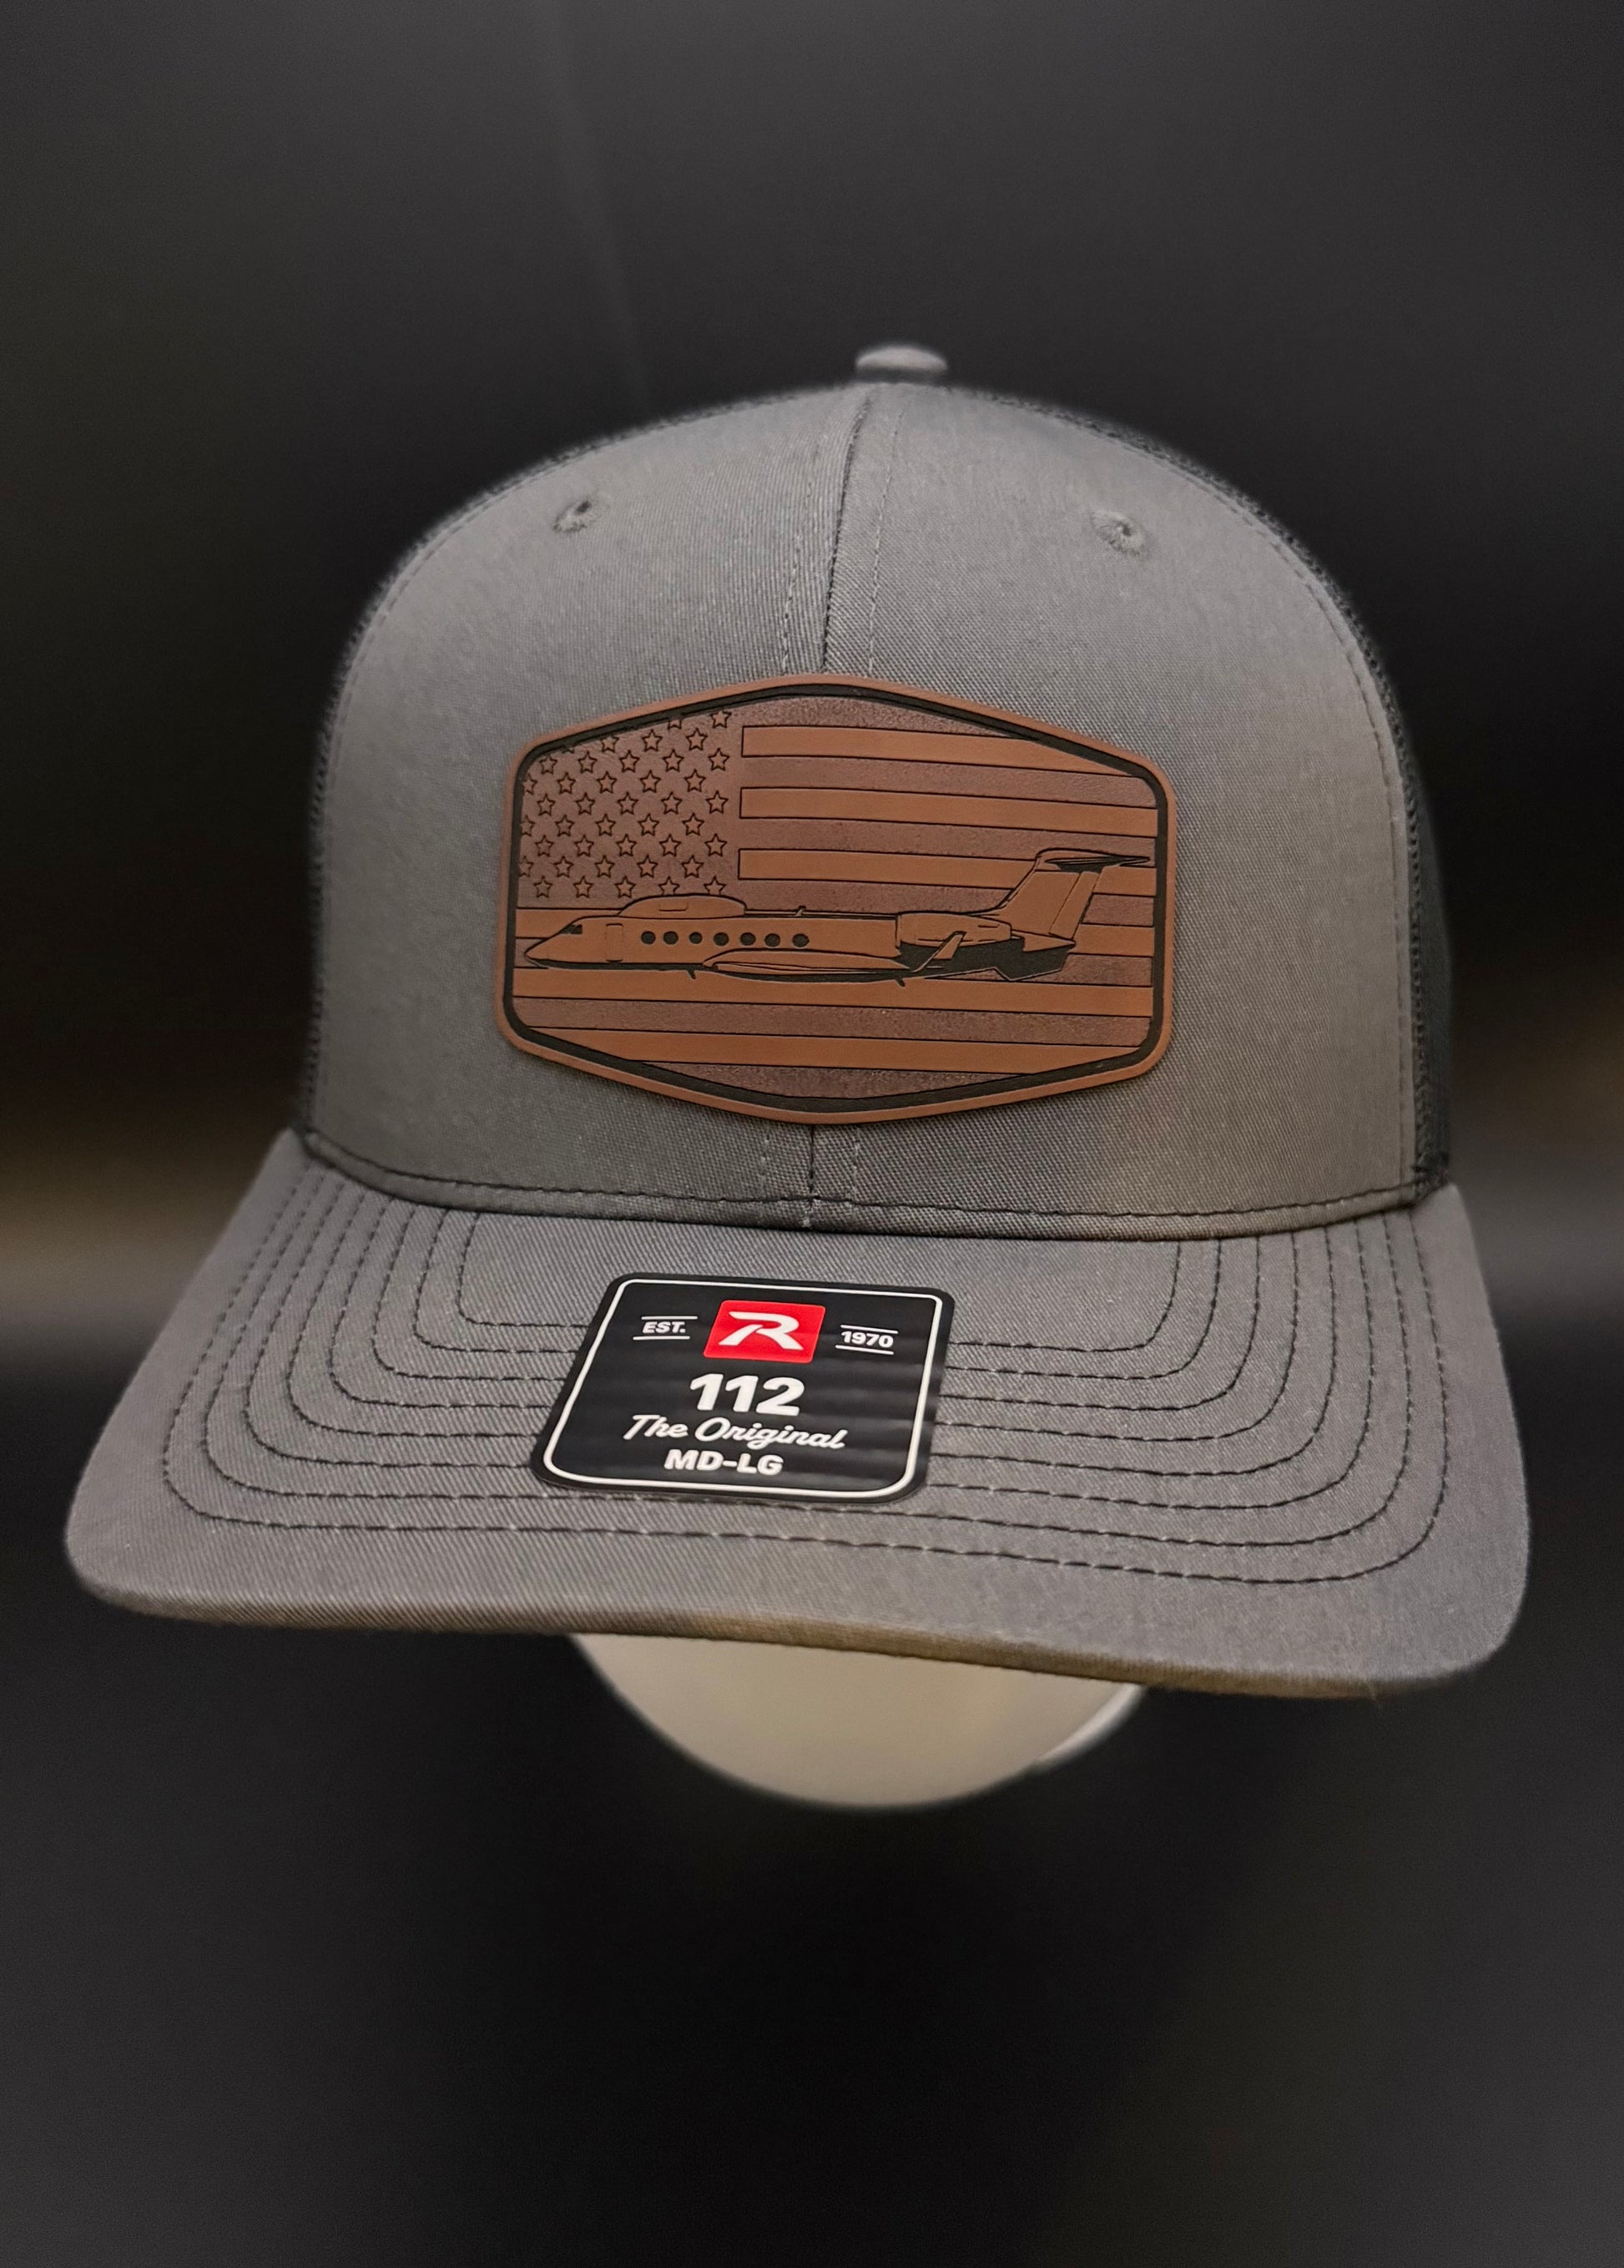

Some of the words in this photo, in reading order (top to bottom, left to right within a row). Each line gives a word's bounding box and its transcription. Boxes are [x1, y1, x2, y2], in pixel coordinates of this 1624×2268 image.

[642, 1321, 686, 1334] EST.
[718, 1311, 804, 1351] R
[840, 1331, 894, 1348] 1970
[689, 1373, 805, 1417] 112
[623, 1414, 688, 1441] The
[694, 1417, 849, 1450] Original
[663, 1448, 784, 1476] MD-LG
